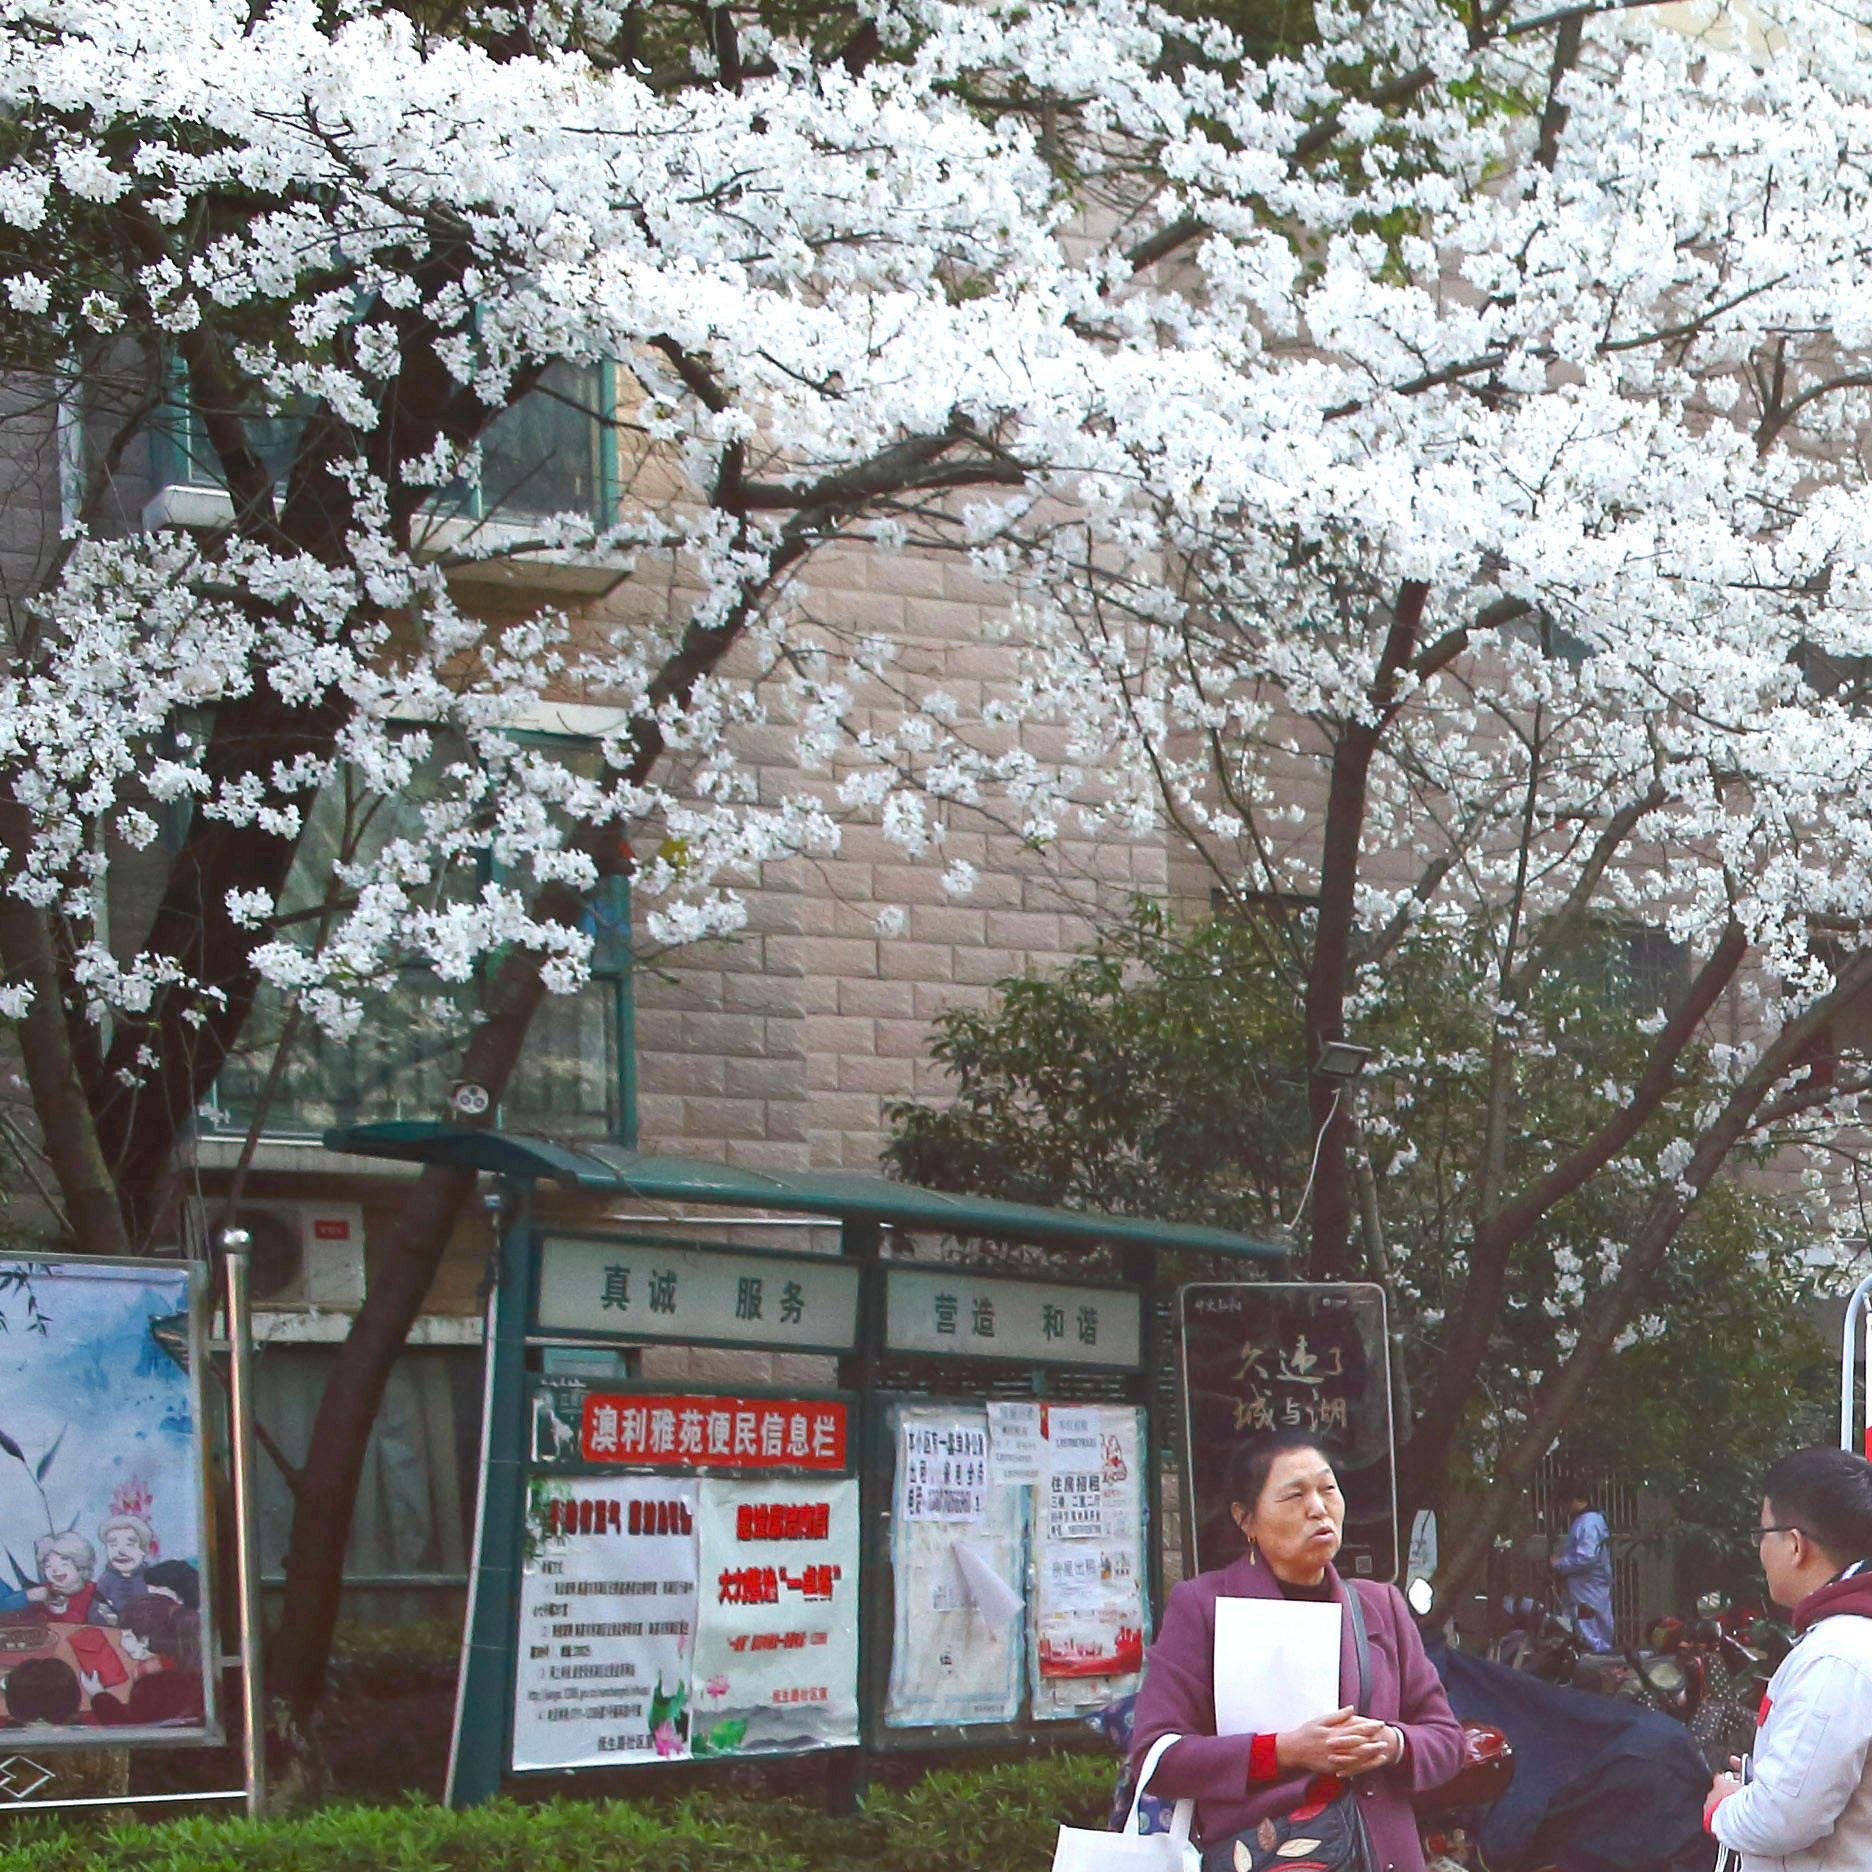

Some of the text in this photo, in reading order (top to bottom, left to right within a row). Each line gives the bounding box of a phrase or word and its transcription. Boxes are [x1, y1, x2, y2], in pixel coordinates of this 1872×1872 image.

[600, 1263, 805, 1324] 真诚 服务
[934, 1293, 1099, 1345] 营造 和谐
[590, 1404, 837, 1458] 澳利雅苑便民信息栏
